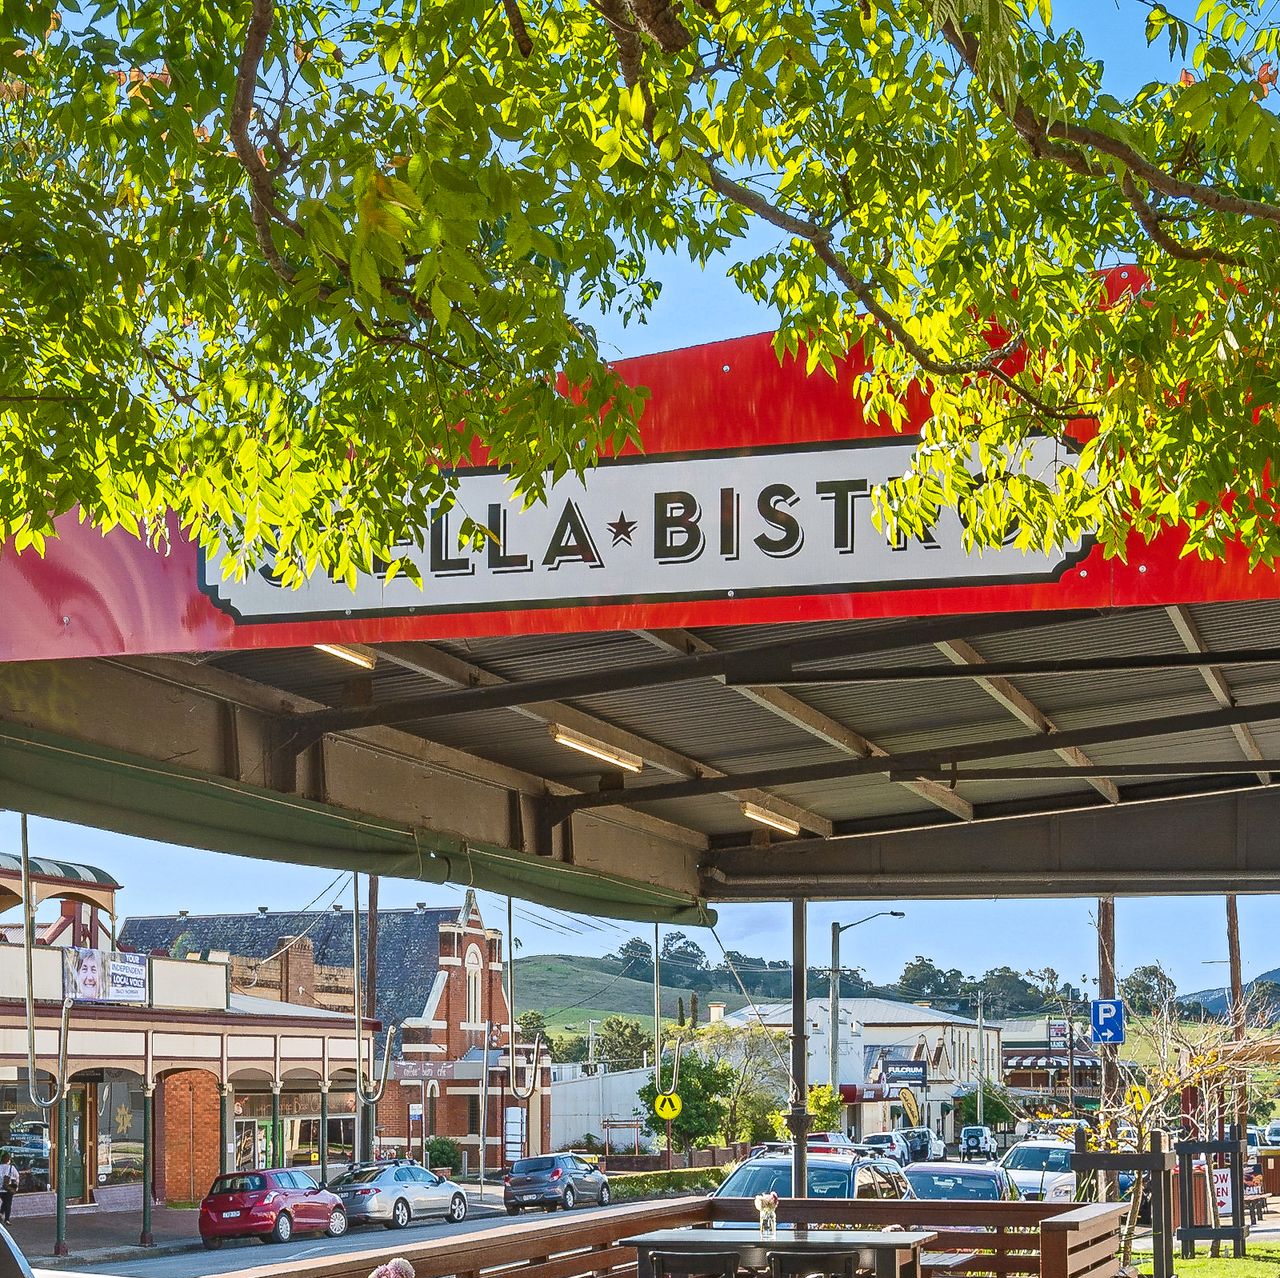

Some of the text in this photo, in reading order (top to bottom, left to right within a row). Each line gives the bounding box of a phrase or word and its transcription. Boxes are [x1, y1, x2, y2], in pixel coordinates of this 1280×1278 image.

[258, 498, 605, 588] LLA
[126, 954, 140, 962] YOUR
[112, 963, 143, 975] INDEPENDENT
[113, 975, 144, 987] LOCAL VOICE
[1099, 1004, 1116, 1025] P
[1213, 1174, 1228, 1184] OW
[1216, 1187, 1228, 1197] EN
